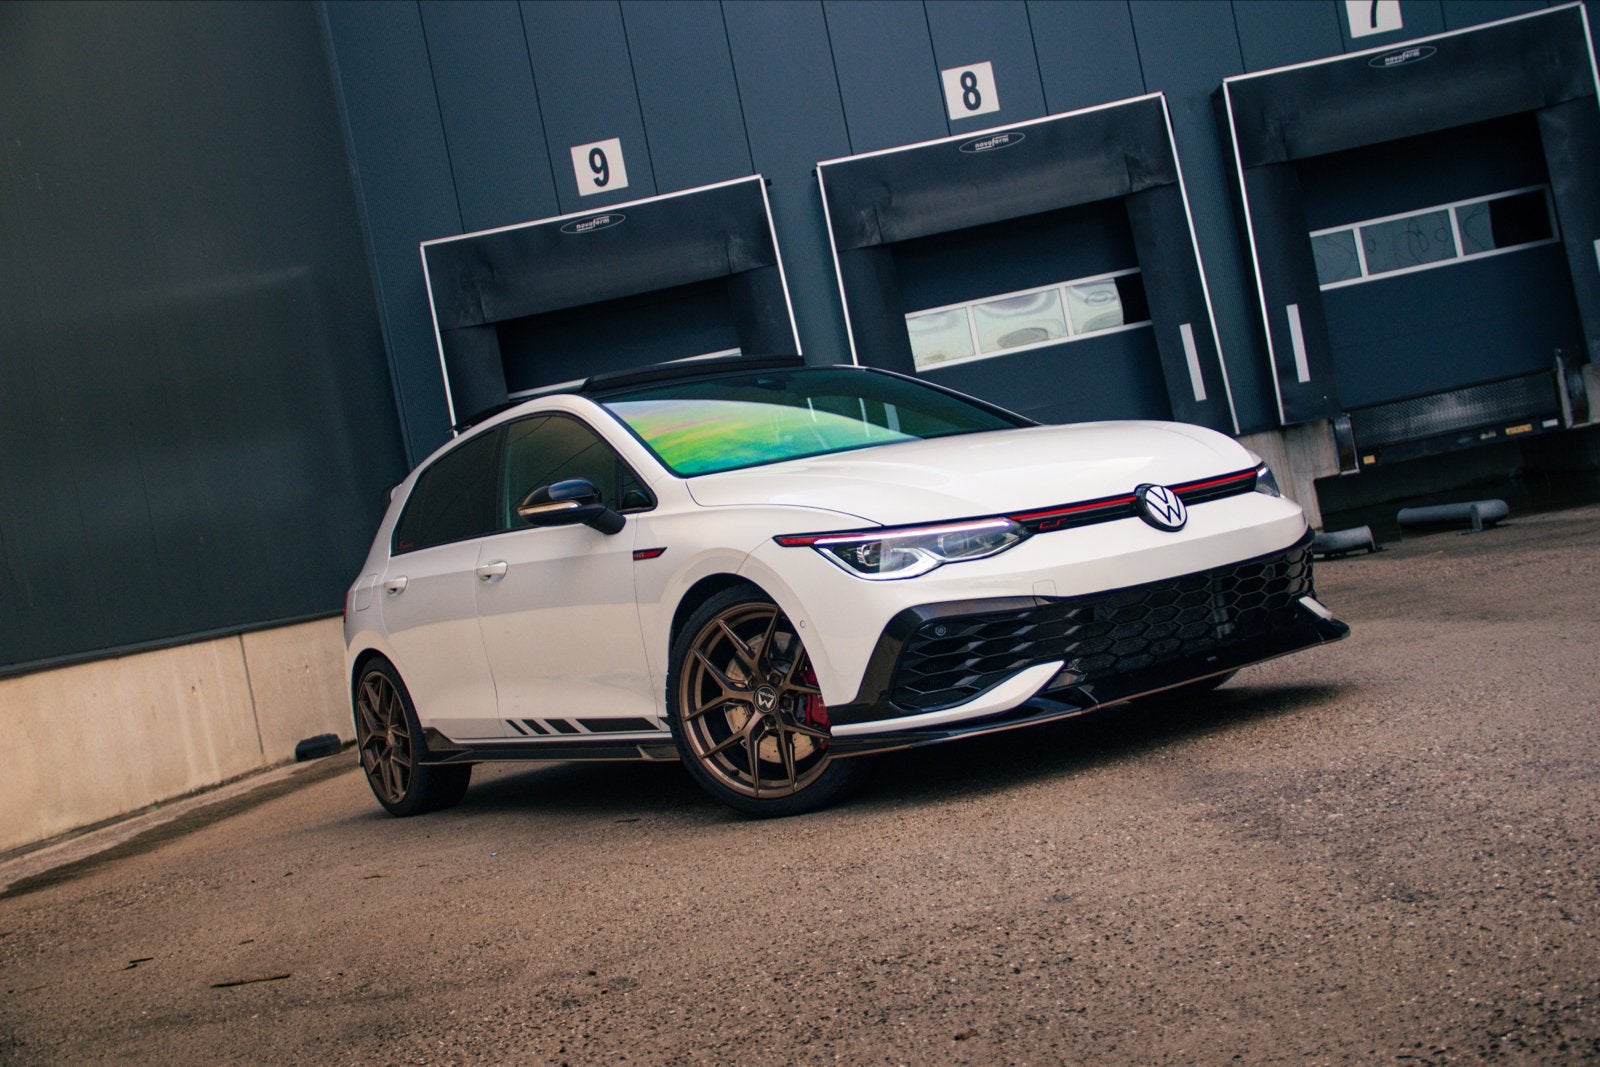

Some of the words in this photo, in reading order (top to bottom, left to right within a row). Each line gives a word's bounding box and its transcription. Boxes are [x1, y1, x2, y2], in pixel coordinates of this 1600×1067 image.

[960, 71, 982, 111] 8
[975, 135, 1009, 150] novoferm
[588, 147, 610, 187] 9
